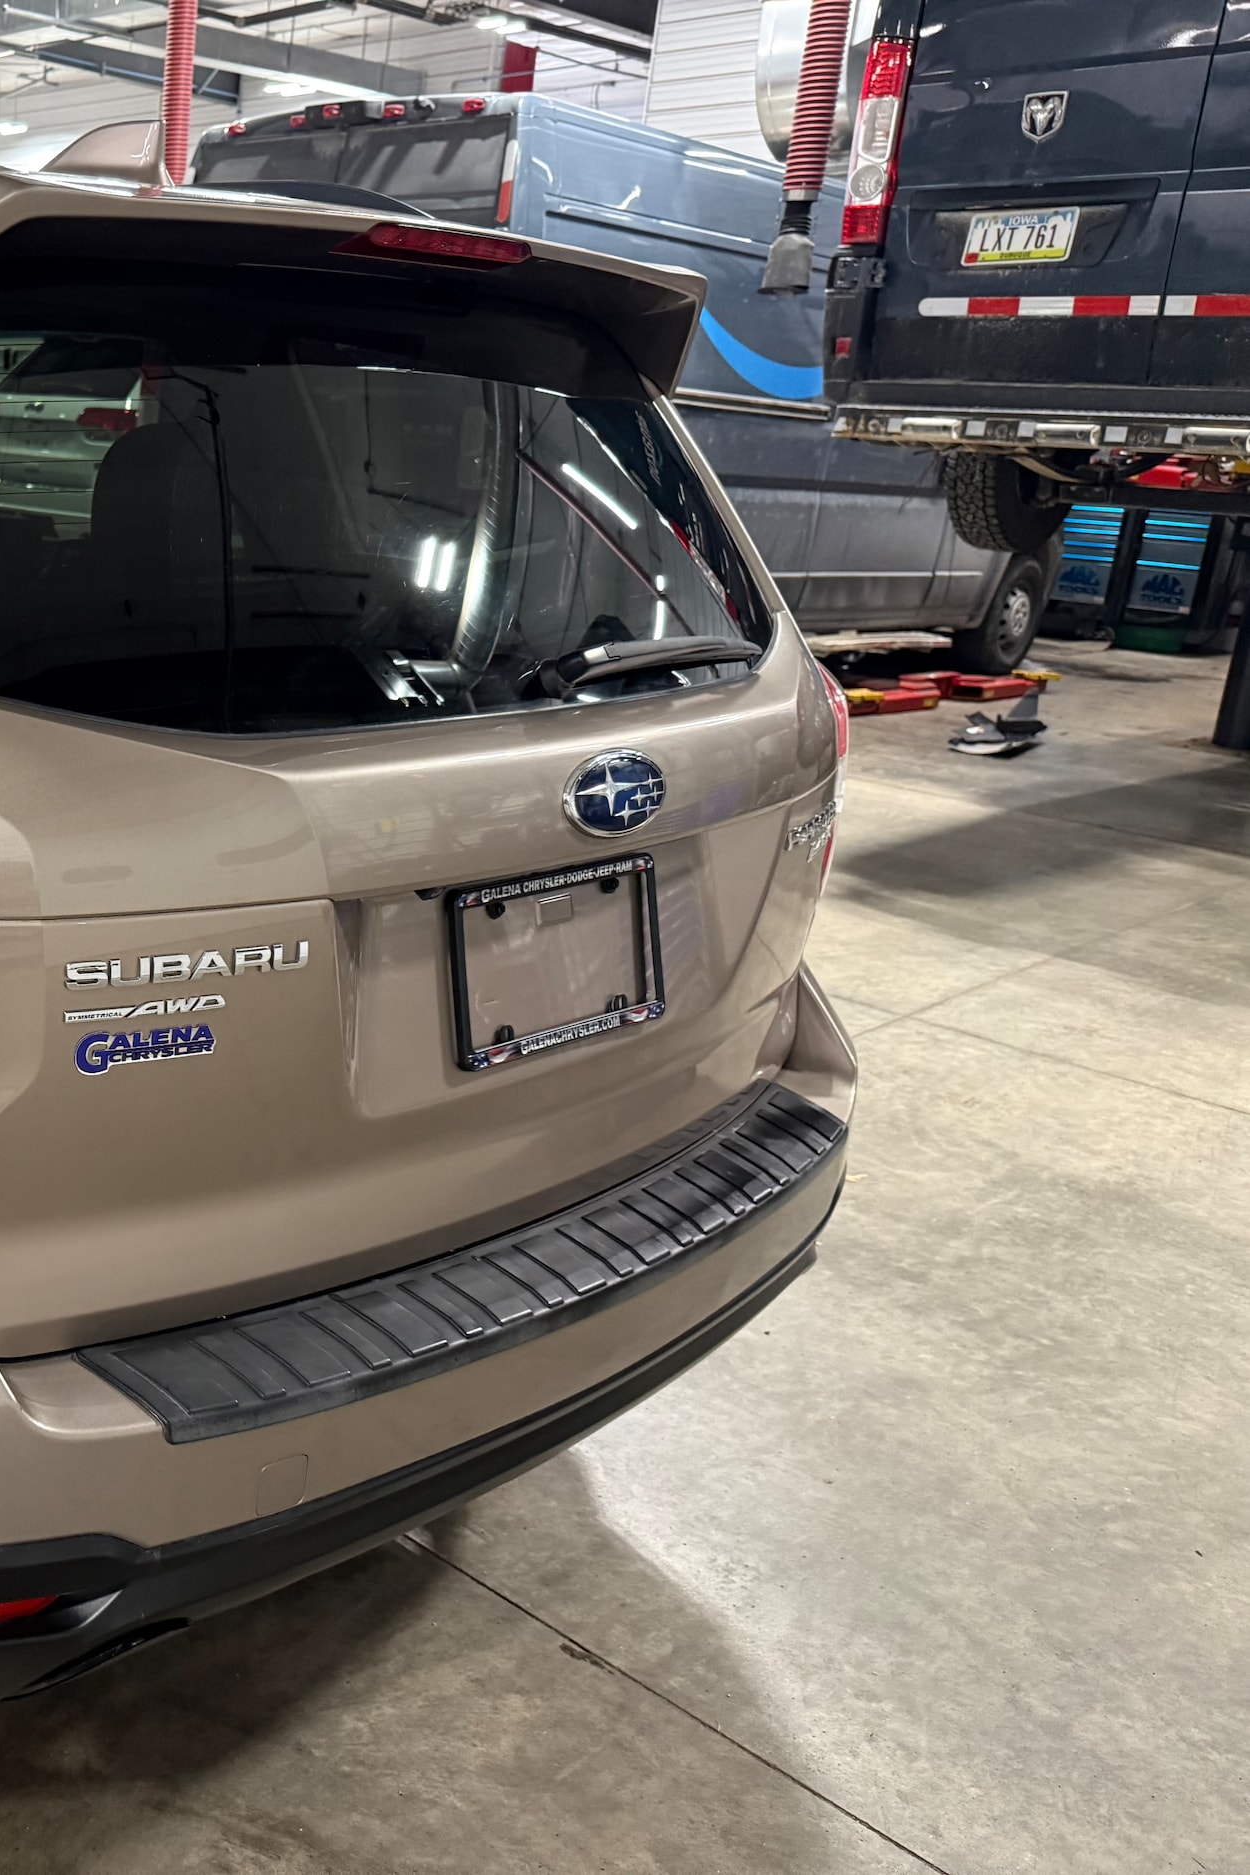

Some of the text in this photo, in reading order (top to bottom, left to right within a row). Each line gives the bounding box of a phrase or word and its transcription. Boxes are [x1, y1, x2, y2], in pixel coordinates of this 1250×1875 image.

[1008, 214, 1039, 226] IOWA
[979, 223, 1058, 252] LXT 761
[481, 884, 522, 903] GALENA
[65, 940, 309, 991] SUBARU
[67, 994, 227, 1022] SYMMETRICAL AWD
[520, 1013, 622, 1055] GALENACHRYSLER.COM
[75, 1024, 215, 1076] GALENA
[108, 1042, 214, 1063] CHRYSLER
